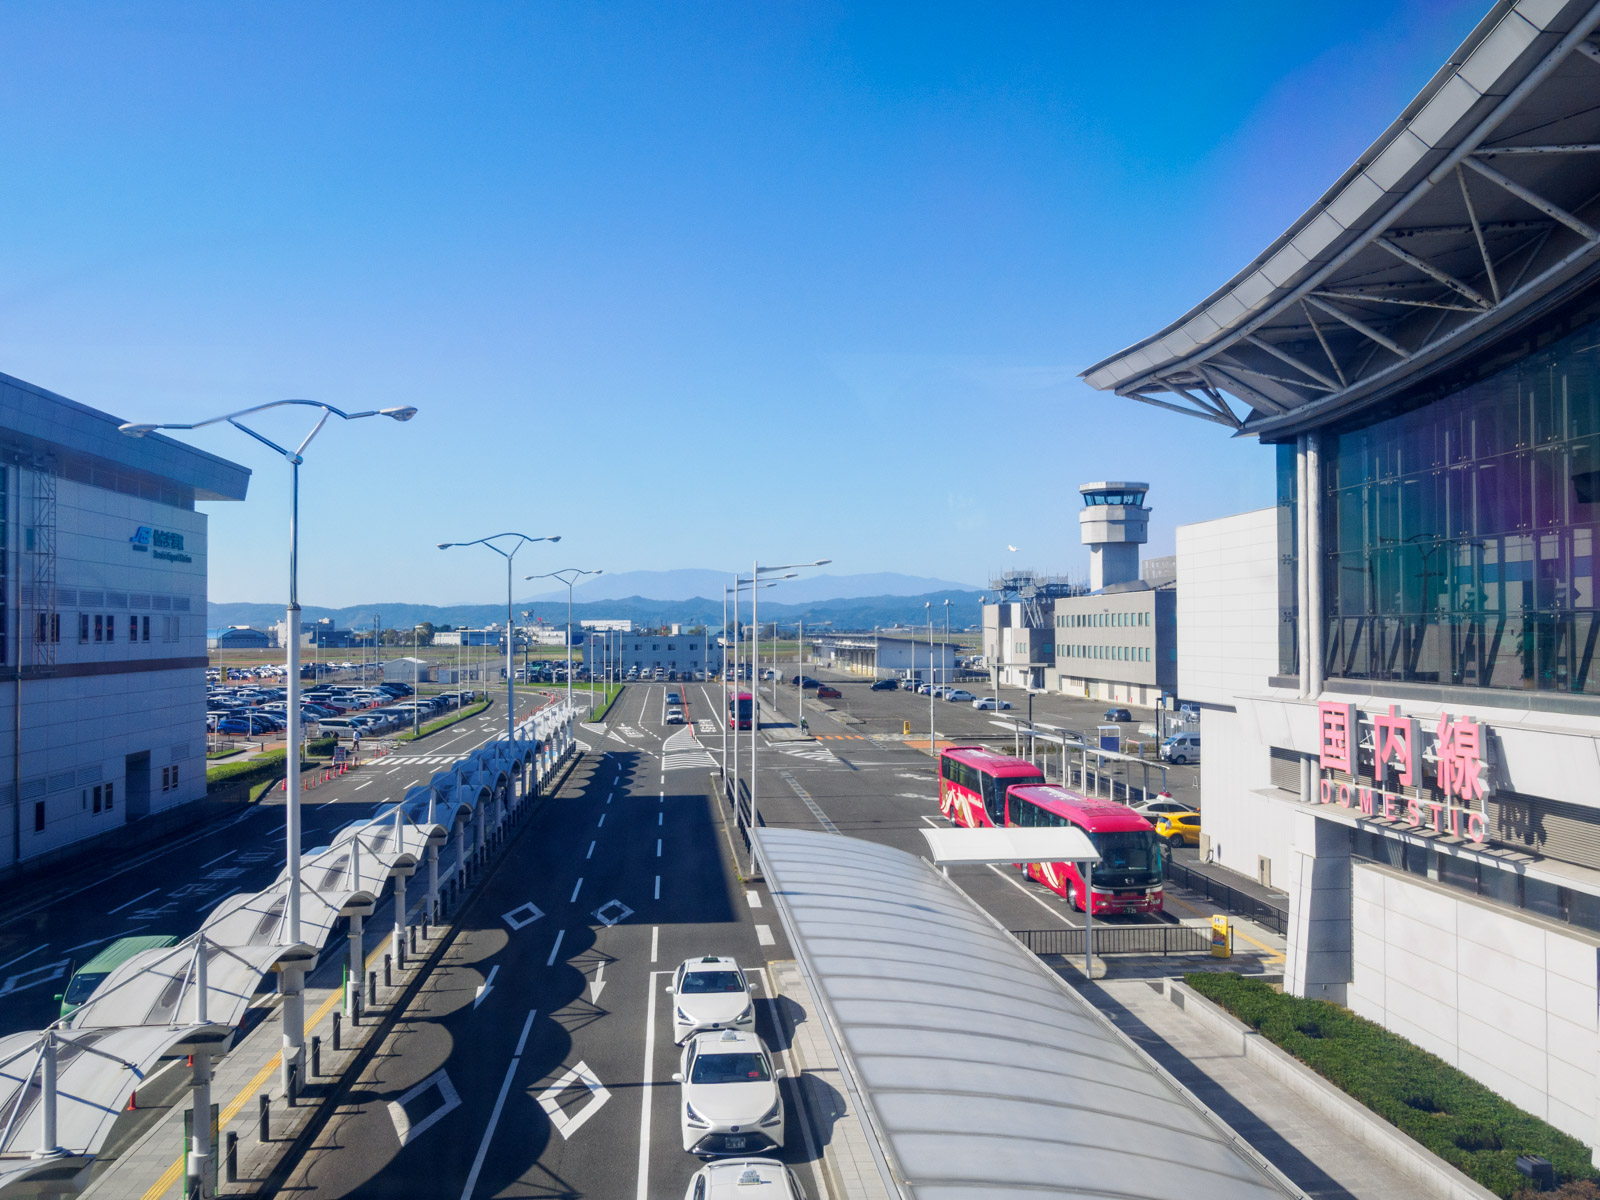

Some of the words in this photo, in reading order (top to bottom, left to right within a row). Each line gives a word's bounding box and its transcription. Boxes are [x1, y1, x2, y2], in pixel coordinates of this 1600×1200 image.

[1319, 701, 1485, 800] 国内線
[1320, 778, 1486, 844] DOMESTIC
